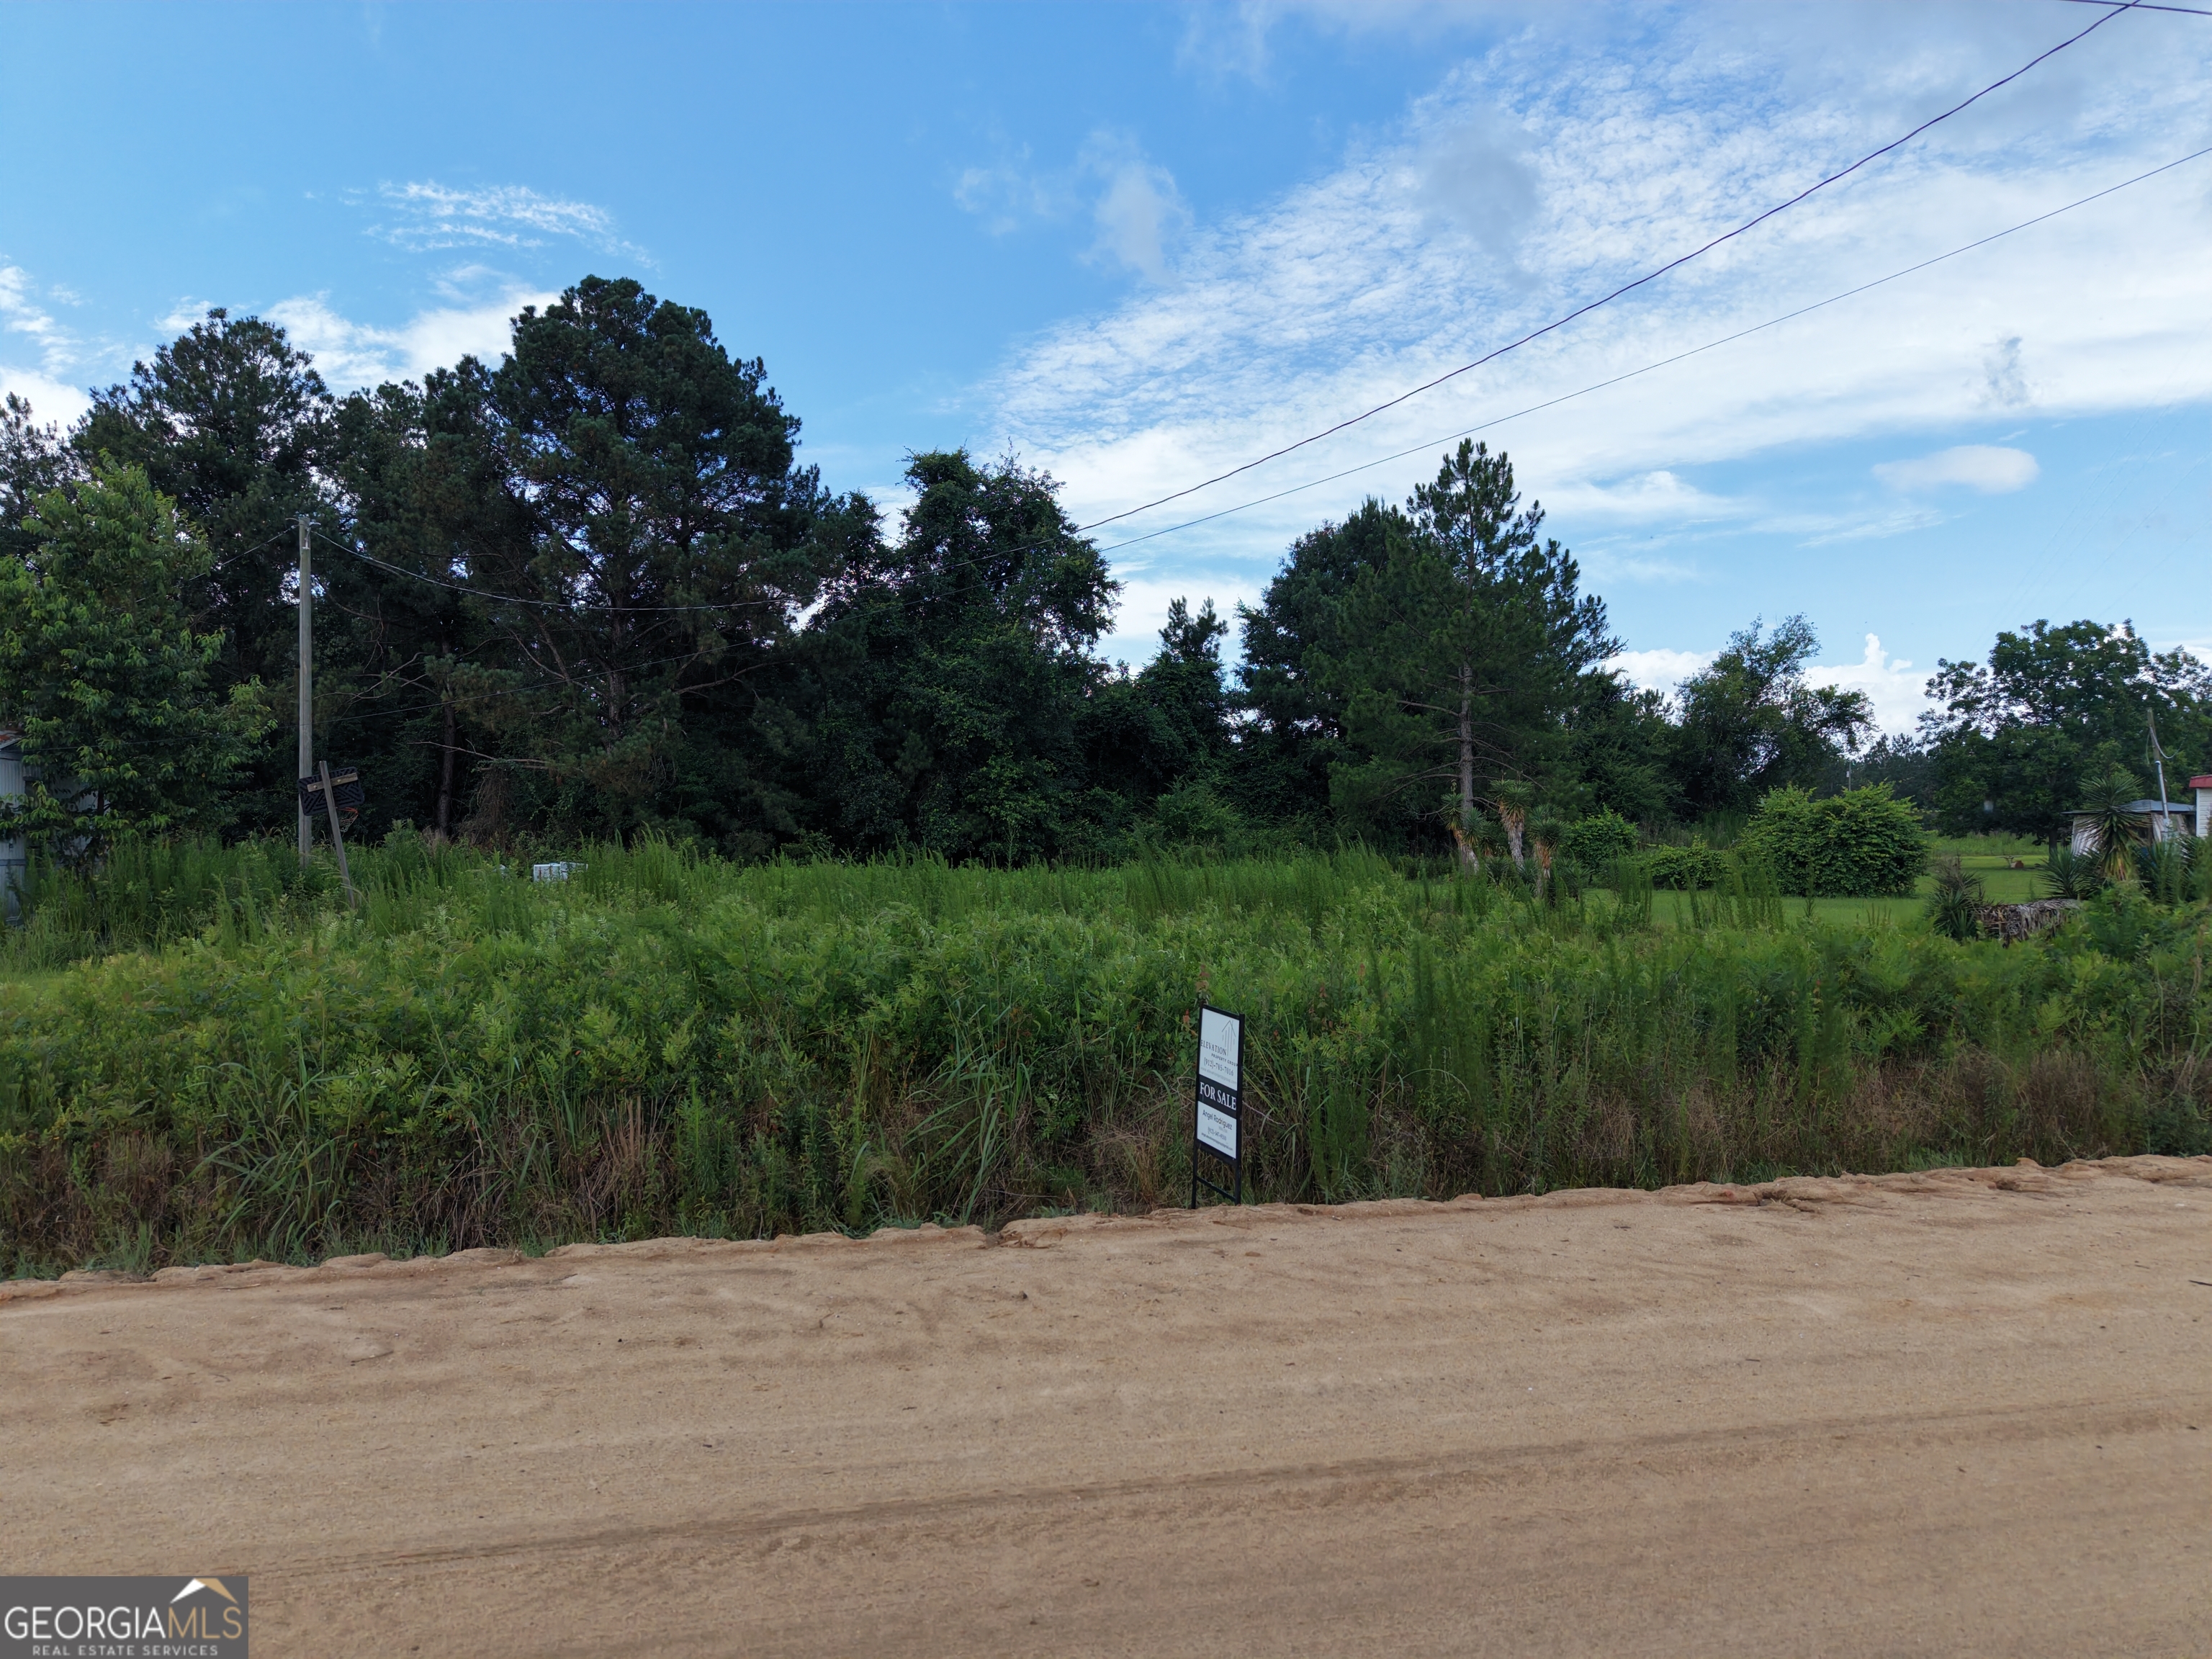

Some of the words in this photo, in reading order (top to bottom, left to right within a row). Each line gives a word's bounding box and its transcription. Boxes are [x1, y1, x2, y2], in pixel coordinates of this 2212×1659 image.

[1200, 1040, 1226, 1056] ELEVATION
[1200, 1082, 1216, 1101] FOR
[1217, 1089, 1237, 1110] SALE
[1202, 1110, 1213, 1120] Angel
[1214, 1115, 1233, 1130] Rodriguez
